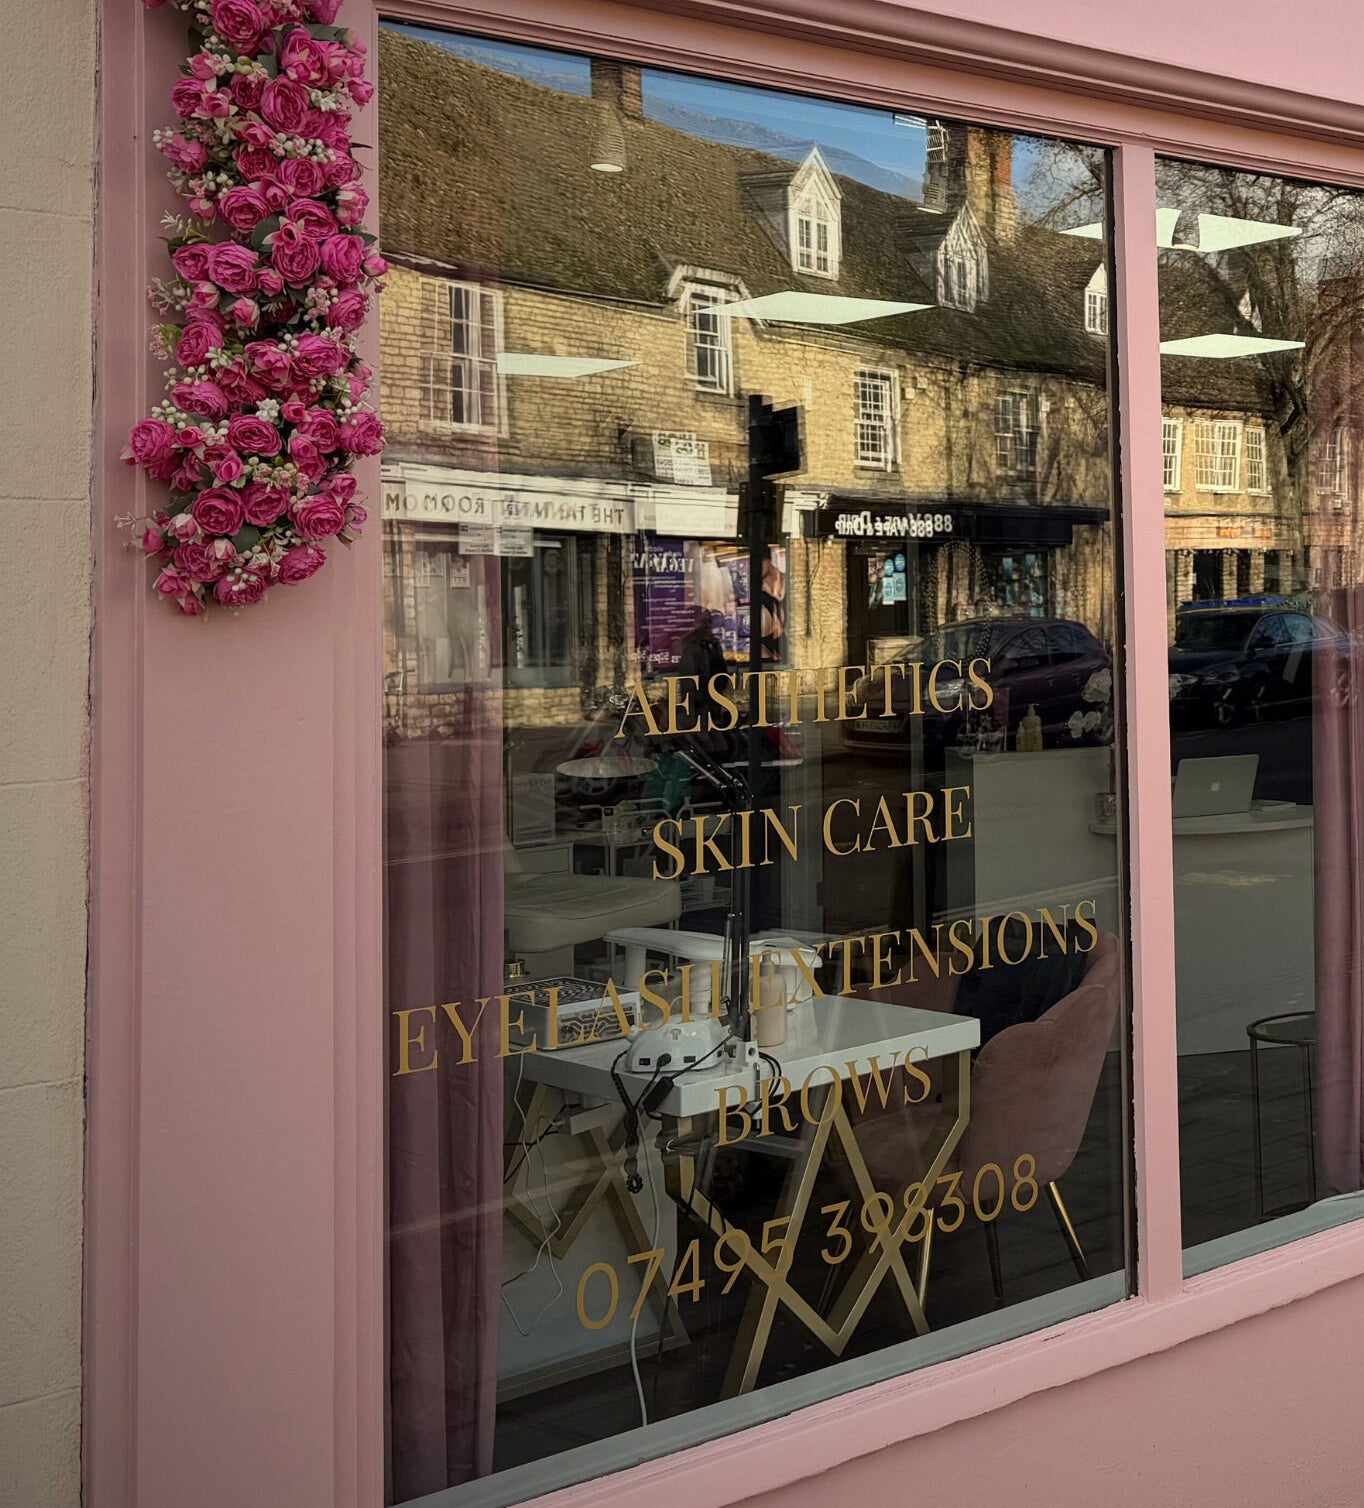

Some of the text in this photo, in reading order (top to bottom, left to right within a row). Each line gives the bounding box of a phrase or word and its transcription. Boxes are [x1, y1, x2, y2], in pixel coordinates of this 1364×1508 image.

[614, 657, 994, 740] AESTHETICS
[652, 785, 973, 881] SKIN CARE
[391, 899, 1100, 1077] EYELASH EXTENSIONS
[713, 1045, 932, 1147] BROWS
[575, 1153, 1040, 1331] 07495 398308
